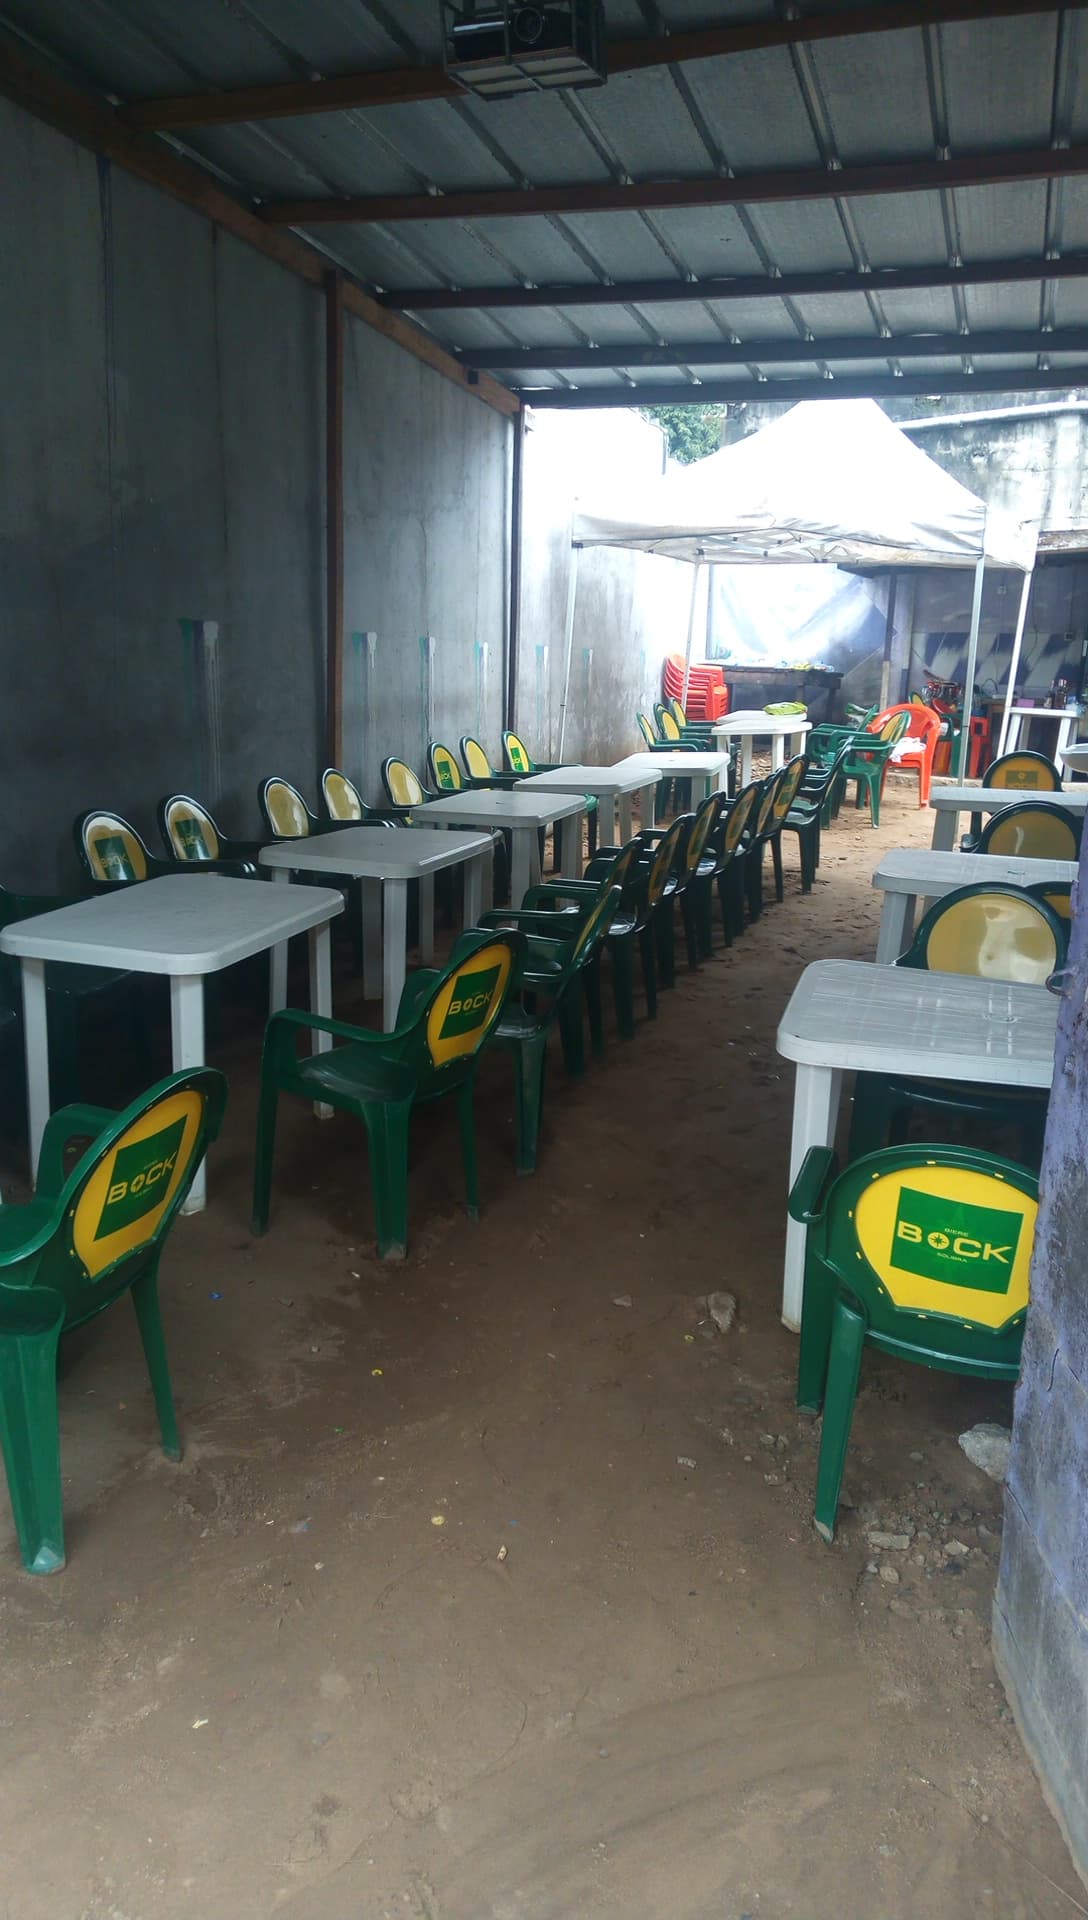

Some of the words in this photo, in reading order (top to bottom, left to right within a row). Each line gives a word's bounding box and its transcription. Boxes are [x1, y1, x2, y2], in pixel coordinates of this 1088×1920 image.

[447, 990, 492, 1015] BOCK
[107, 1151, 178, 1204] BOCK
[897, 1220, 1013, 1264] BOCK
